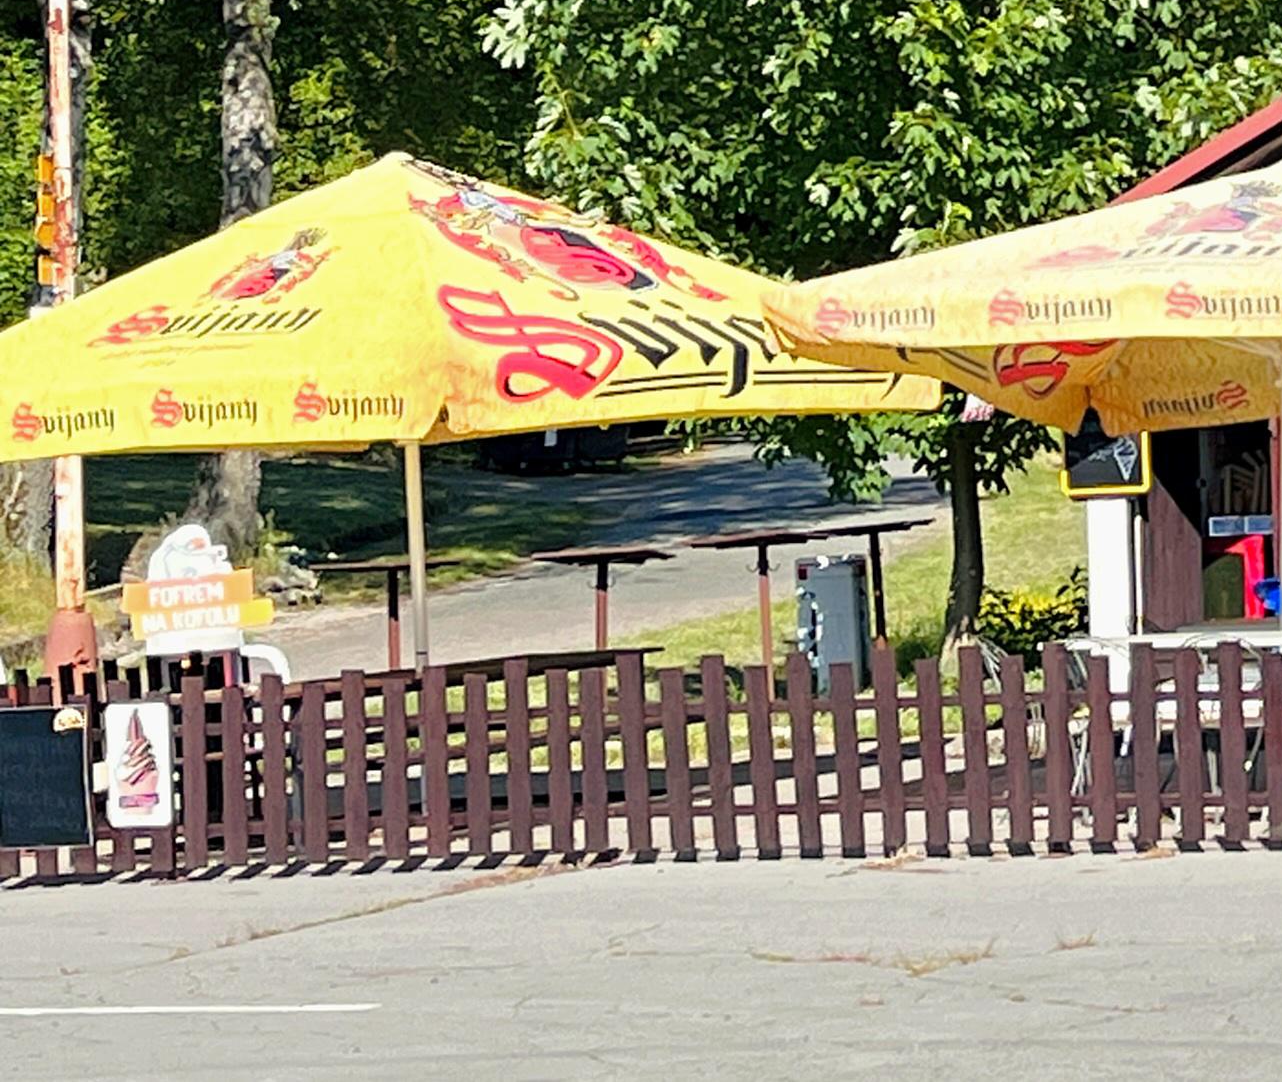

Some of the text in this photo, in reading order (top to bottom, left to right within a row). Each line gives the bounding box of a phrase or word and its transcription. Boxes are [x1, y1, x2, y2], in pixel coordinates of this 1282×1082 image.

[87, 305, 322, 347] Svijany
[815, 296, 937, 335] Svijany
[988, 287, 1112, 326] Svijany
[12, 401, 116, 444] Svijany
[150, 385, 258, 430] Svijany
[292, 382, 404, 425] Svijany
